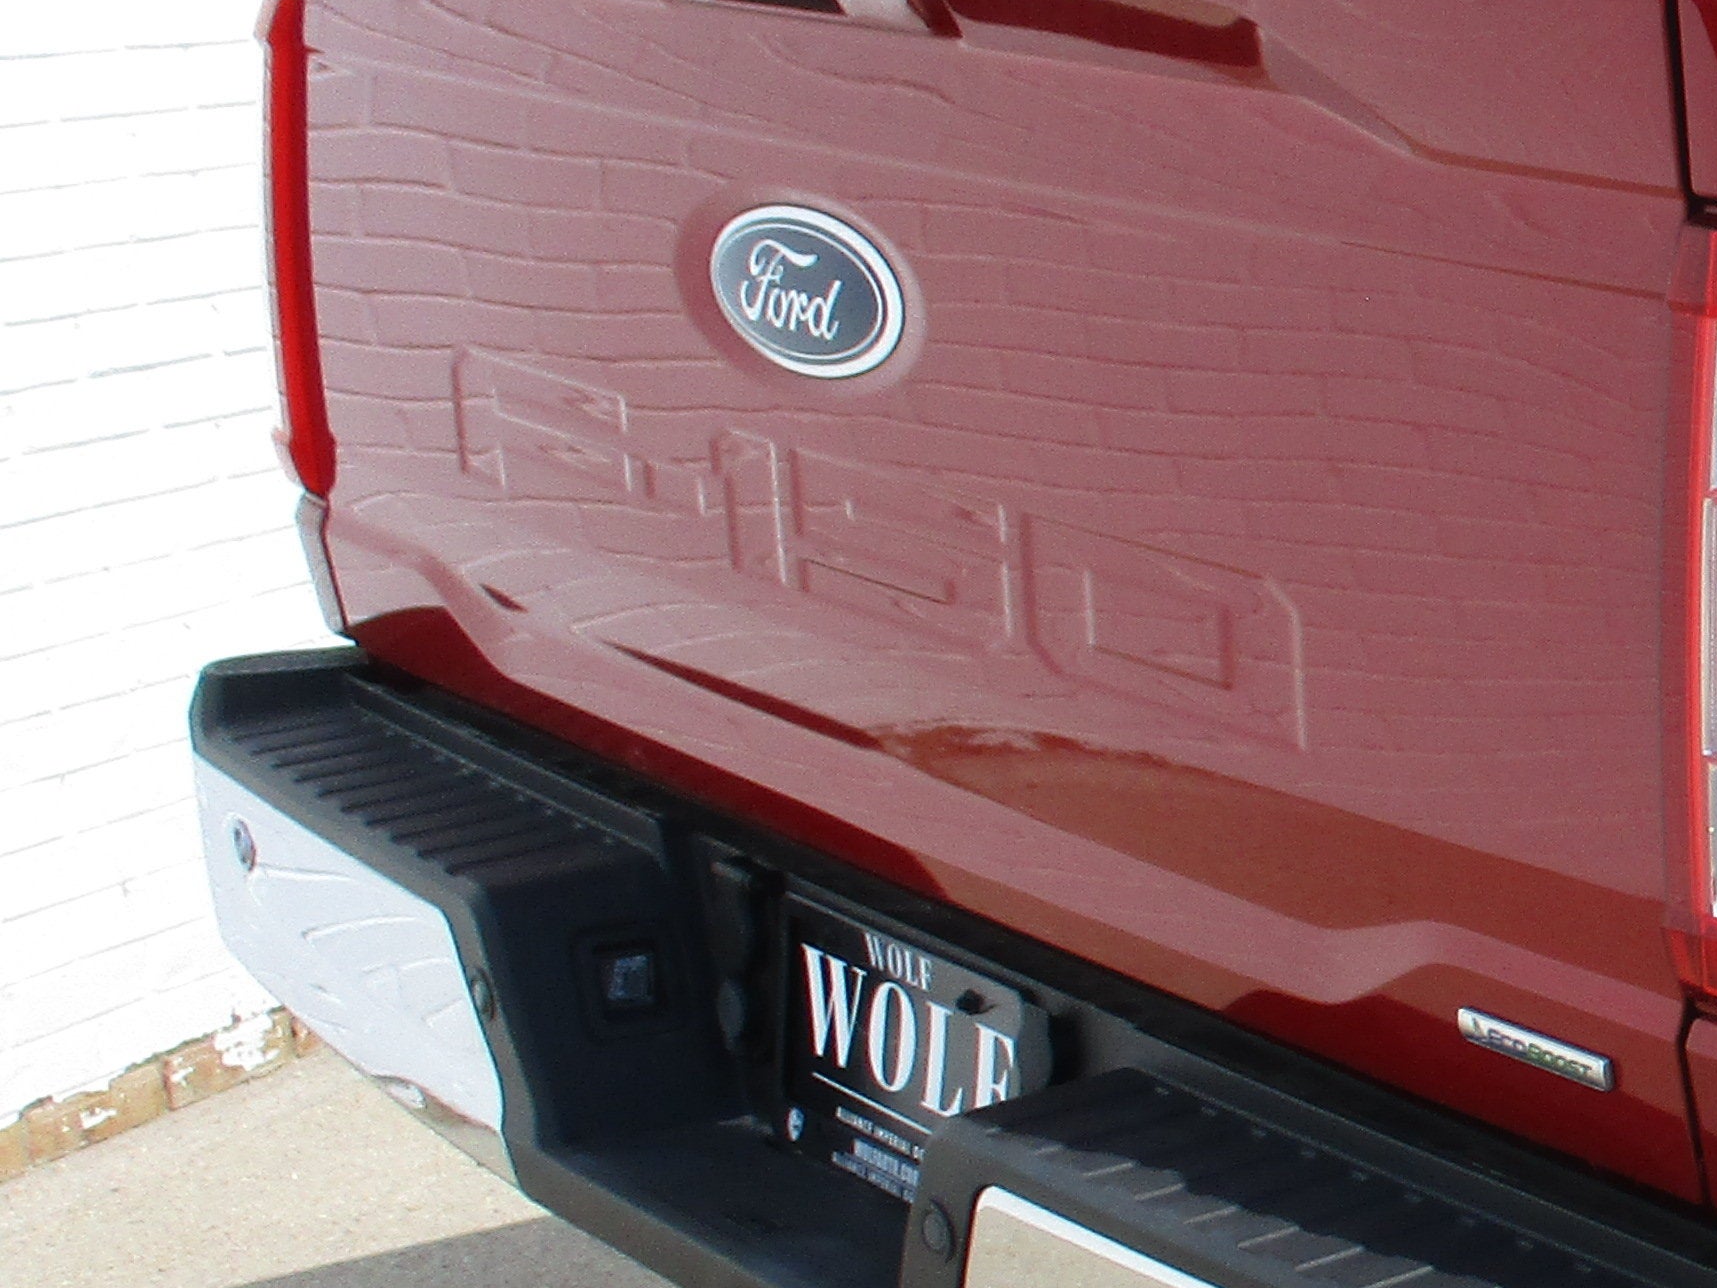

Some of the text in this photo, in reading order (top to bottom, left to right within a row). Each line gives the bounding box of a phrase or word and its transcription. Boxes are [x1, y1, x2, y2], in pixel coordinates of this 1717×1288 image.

[740, 238, 842, 341] Ford
[864, 932, 932, 991] WOLF
[801, 943, 1015, 1117] WOLF
